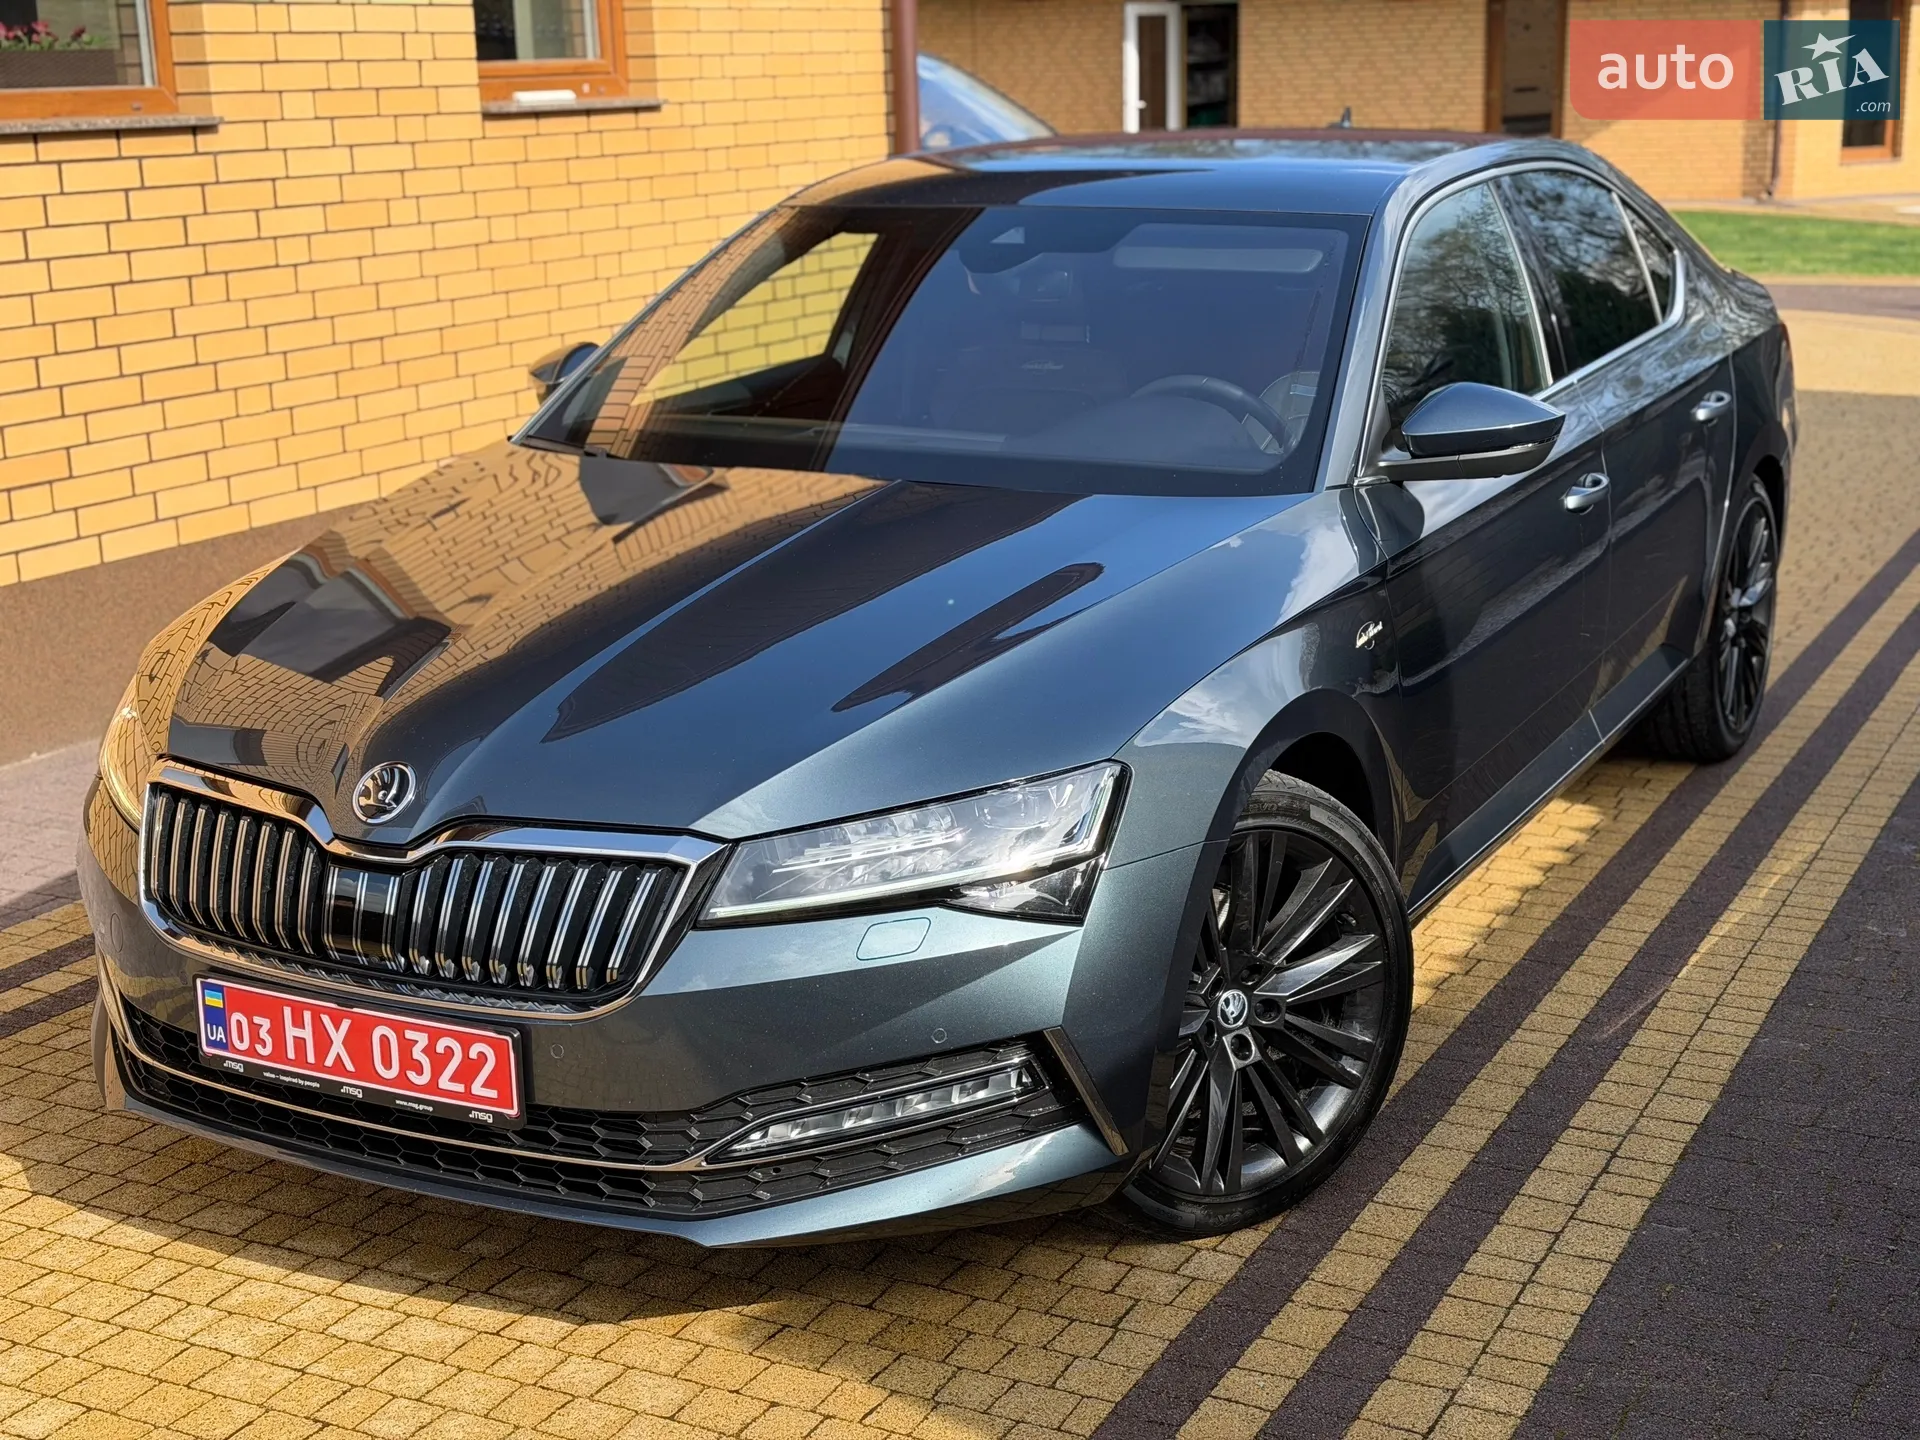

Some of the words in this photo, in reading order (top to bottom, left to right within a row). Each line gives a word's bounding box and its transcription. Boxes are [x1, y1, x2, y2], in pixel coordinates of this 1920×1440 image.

[207, 1023, 226, 1043] UA
[230, 1012, 272, 1056] 03
[283, 1006, 355, 1072] HX
[372, 1025, 498, 1099] 0322
